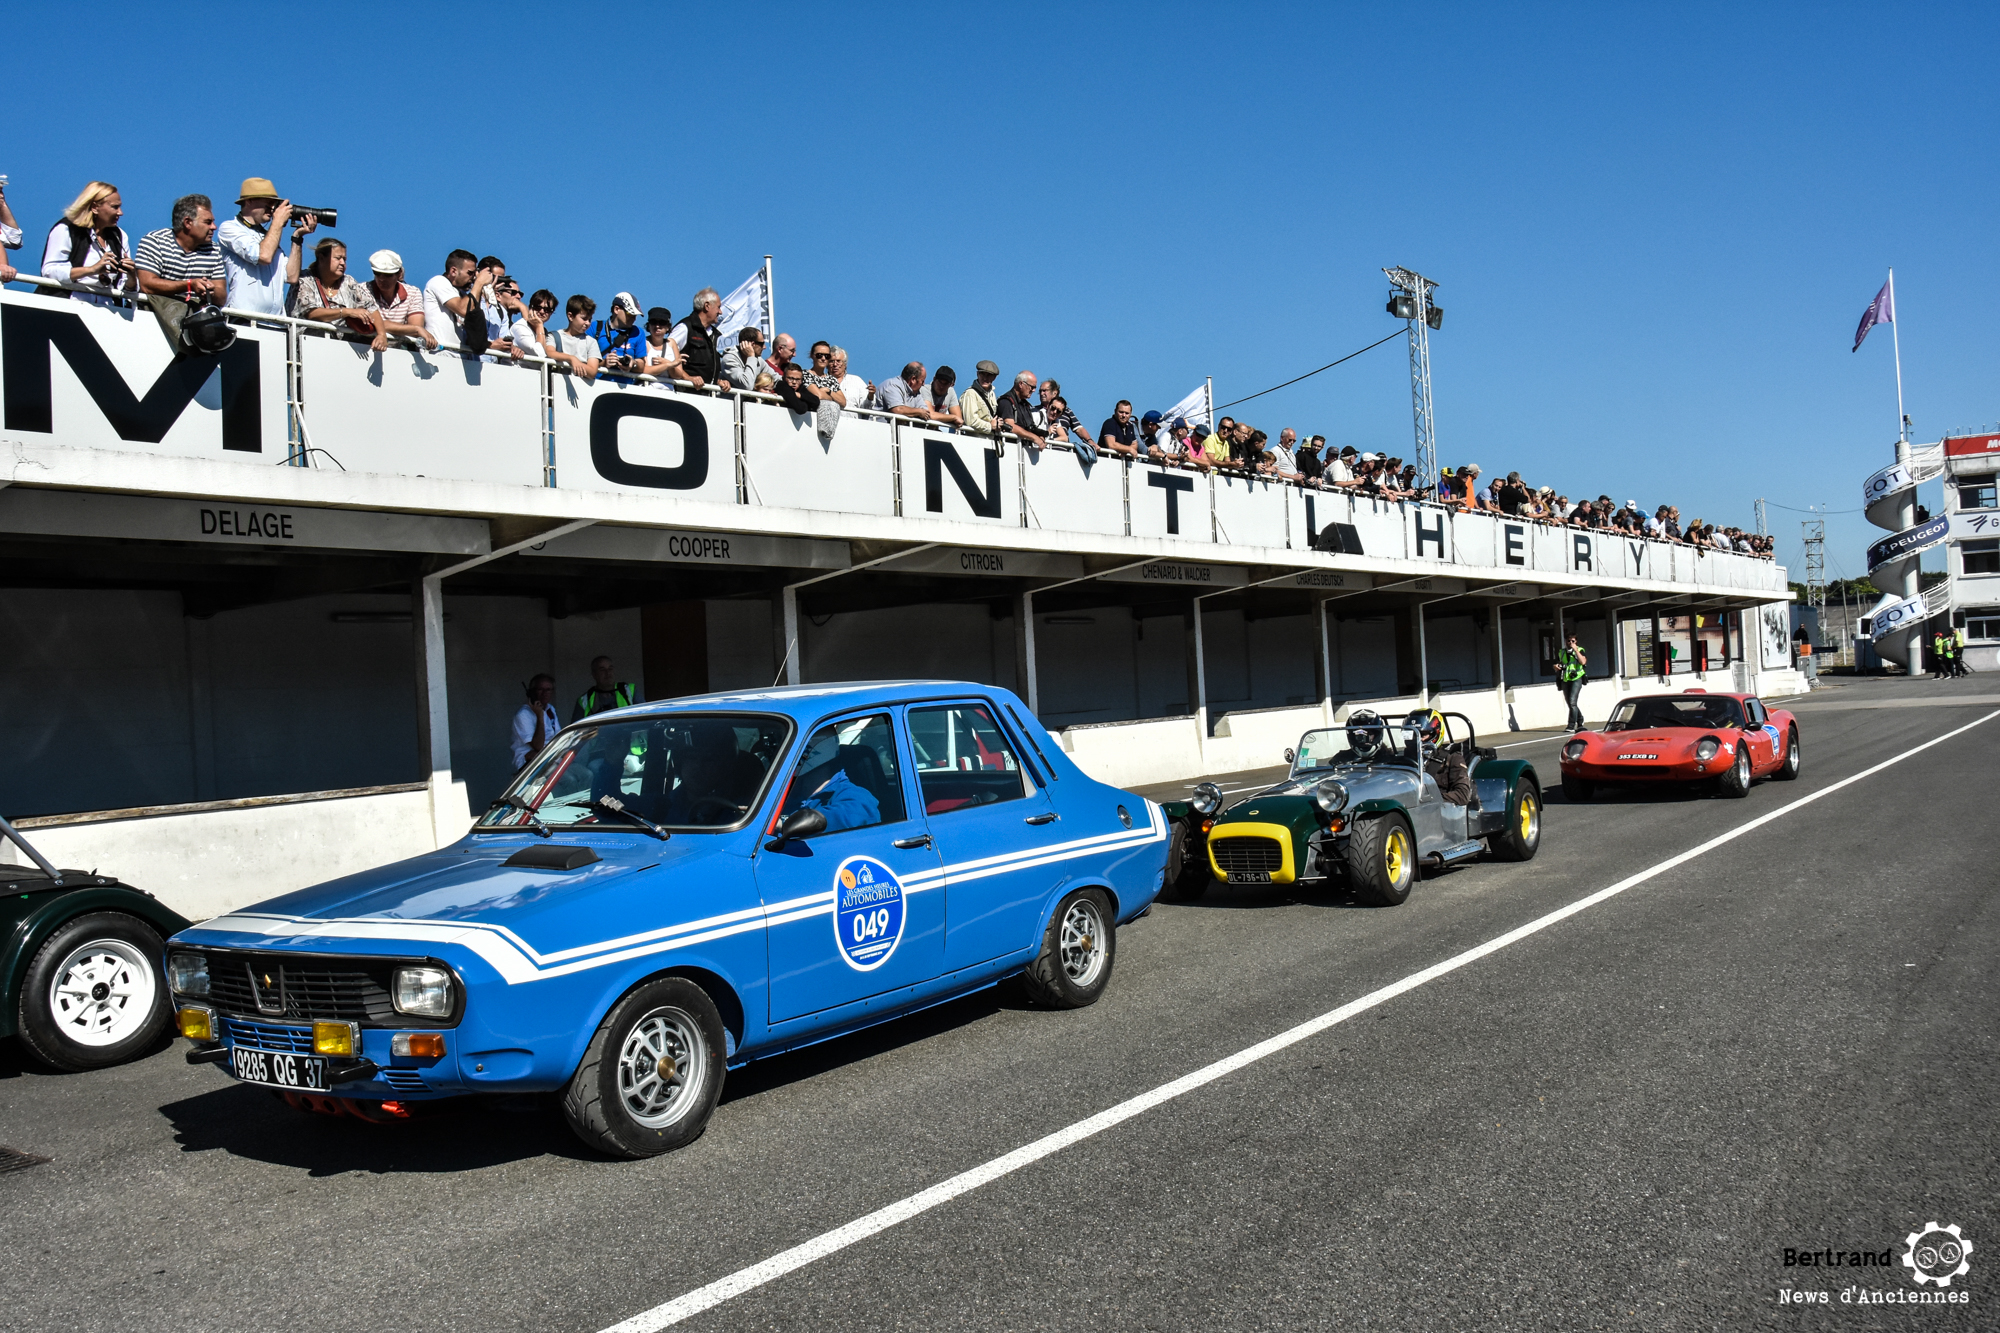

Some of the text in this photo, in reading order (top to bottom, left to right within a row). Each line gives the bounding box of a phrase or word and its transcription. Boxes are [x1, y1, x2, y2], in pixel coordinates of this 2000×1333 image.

[1987, 439, 2000, 449] M
[200, 509, 294, 539] DELAGE
[669, 536, 731, 559] COOPER
[1889, 522, 1945, 551] PEUGEOT
[960, 552, 1004, 571] CITROEN
[1142, 564, 1211, 581] CHENARD & WALCKER
[1321, 574, 1344, 587] DEUTSCH
[842, 886, 898, 908] AUTOMOBILES
[854, 884, 873, 893] GRANDES
[874, 881, 889, 890] HEURES
[853, 908, 889, 942] 049
[236, 1049, 323, 1088] 9285 QG 37
